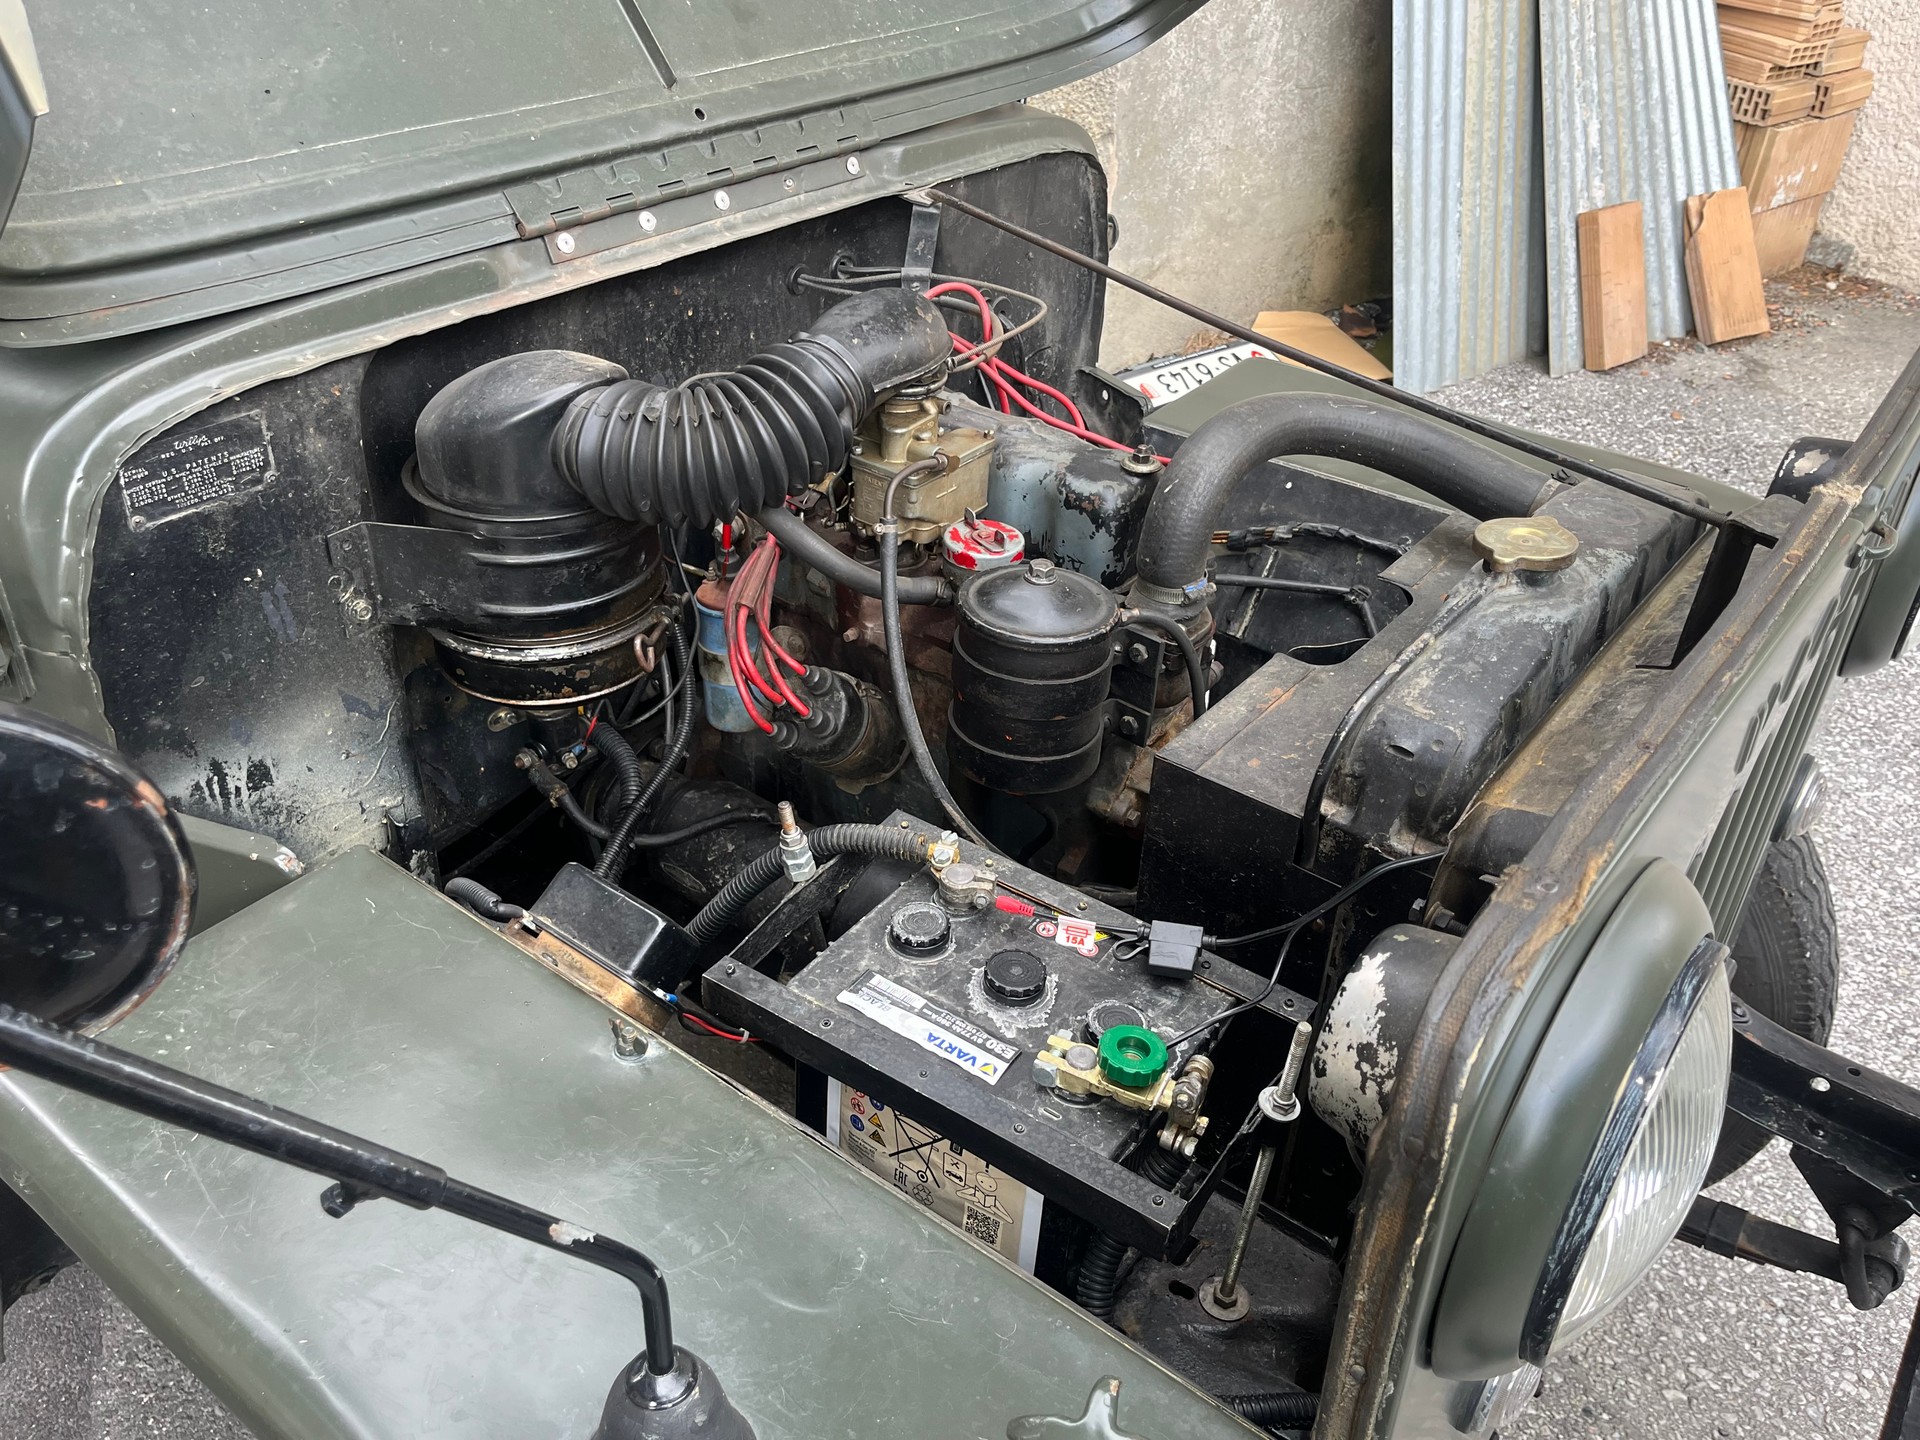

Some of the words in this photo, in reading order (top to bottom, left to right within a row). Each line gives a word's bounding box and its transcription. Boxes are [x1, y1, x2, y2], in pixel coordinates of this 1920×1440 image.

[173, 435, 208, 450] Willys
[185, 451, 229, 470] PATENTS
[124, 467, 146, 477] SERIAL
[1066, 936, 1085, 946] 15A
[952, 1023, 973, 1040] 77Ah
[927, 1031, 978, 1067] VARTA
[986, 1039, 1016, 1060] E30
